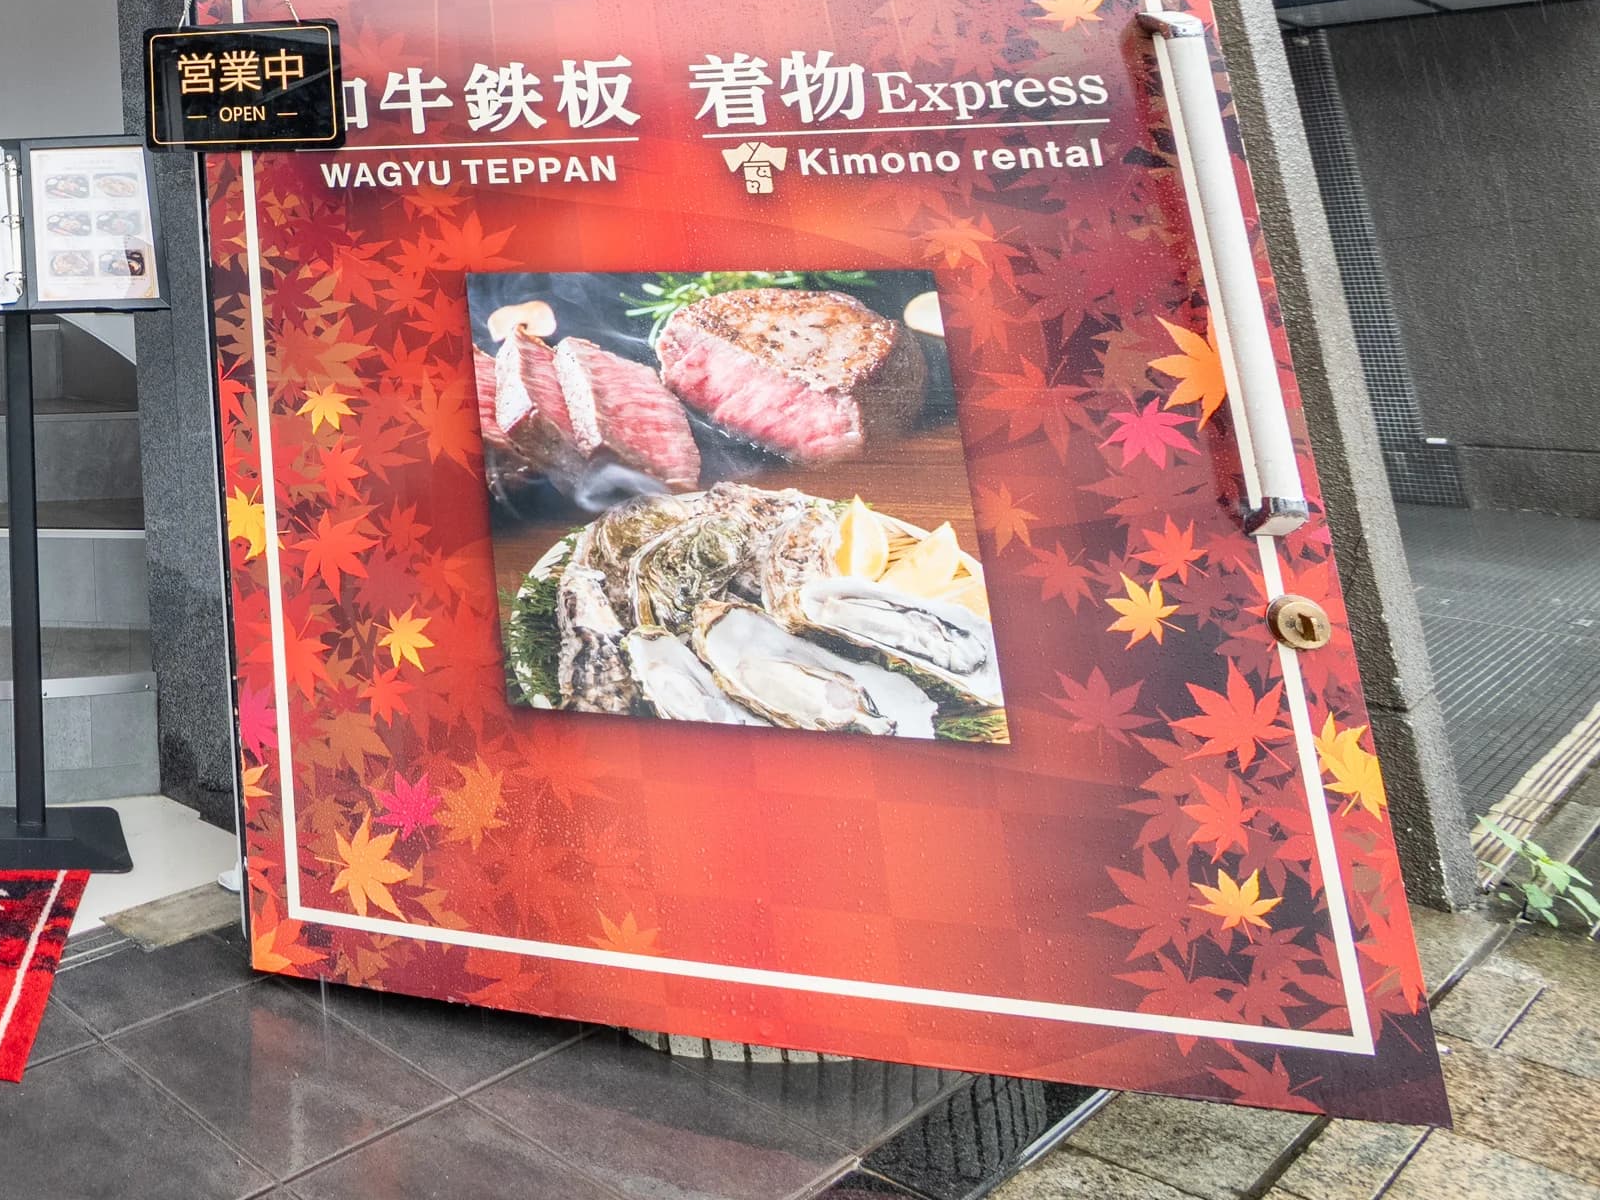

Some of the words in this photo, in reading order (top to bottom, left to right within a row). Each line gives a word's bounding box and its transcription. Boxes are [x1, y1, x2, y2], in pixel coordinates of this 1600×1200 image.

[177, 49, 304, 95] 営業中
[219, 106, 266, 122] OPEN
[320, 159, 451, 188] WAGYU
[462, 155, 617, 185] TEPPAN
[799, 147, 961, 176] Kimono
[974, 138, 1104, 173] rental
